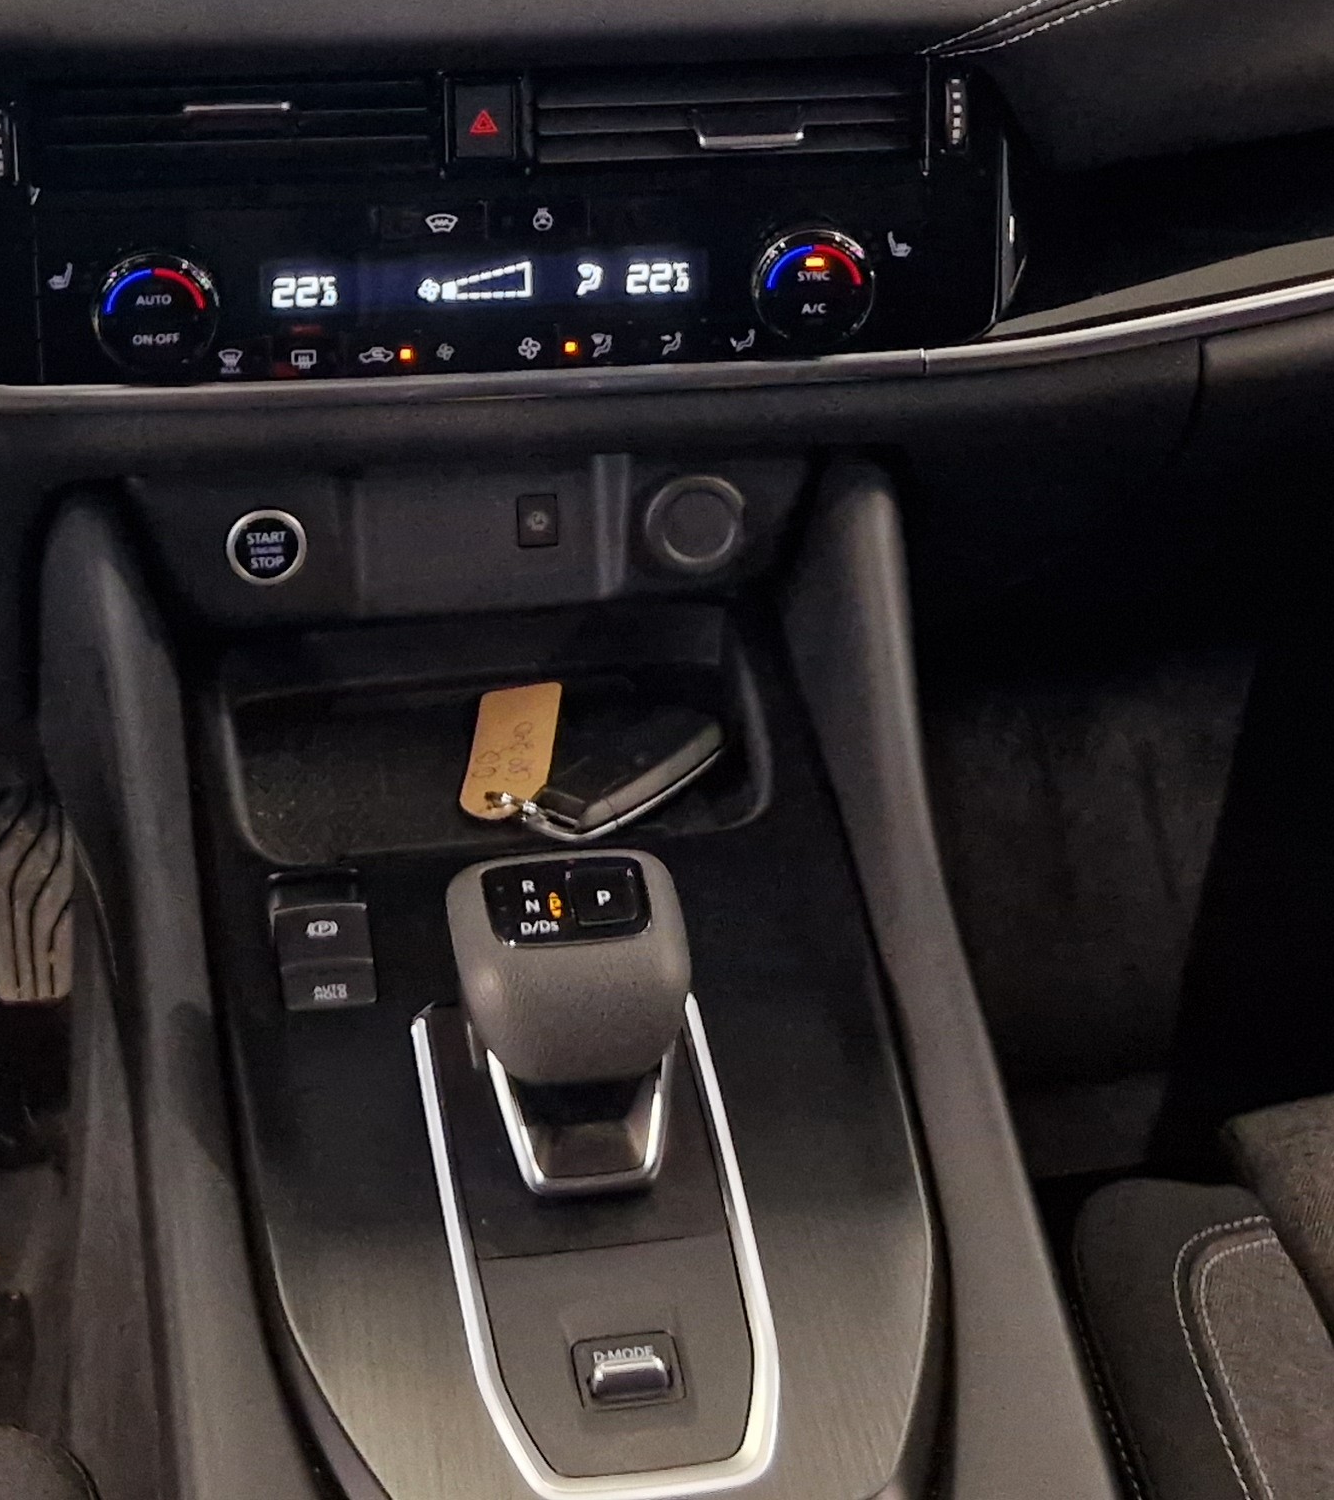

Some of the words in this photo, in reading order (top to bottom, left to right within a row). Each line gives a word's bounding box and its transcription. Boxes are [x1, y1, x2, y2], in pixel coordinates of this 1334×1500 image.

[797, 270, 830, 282] SYNC
[135, 295, 172, 306] AUTO
[801, 303, 827, 315] A/C
[246, 531, 287, 545] START
[250, 555, 285, 570] STOP
[521, 879, 535, 894] R
[596, 889, 611, 906] P
[525, 898, 541, 914] N
